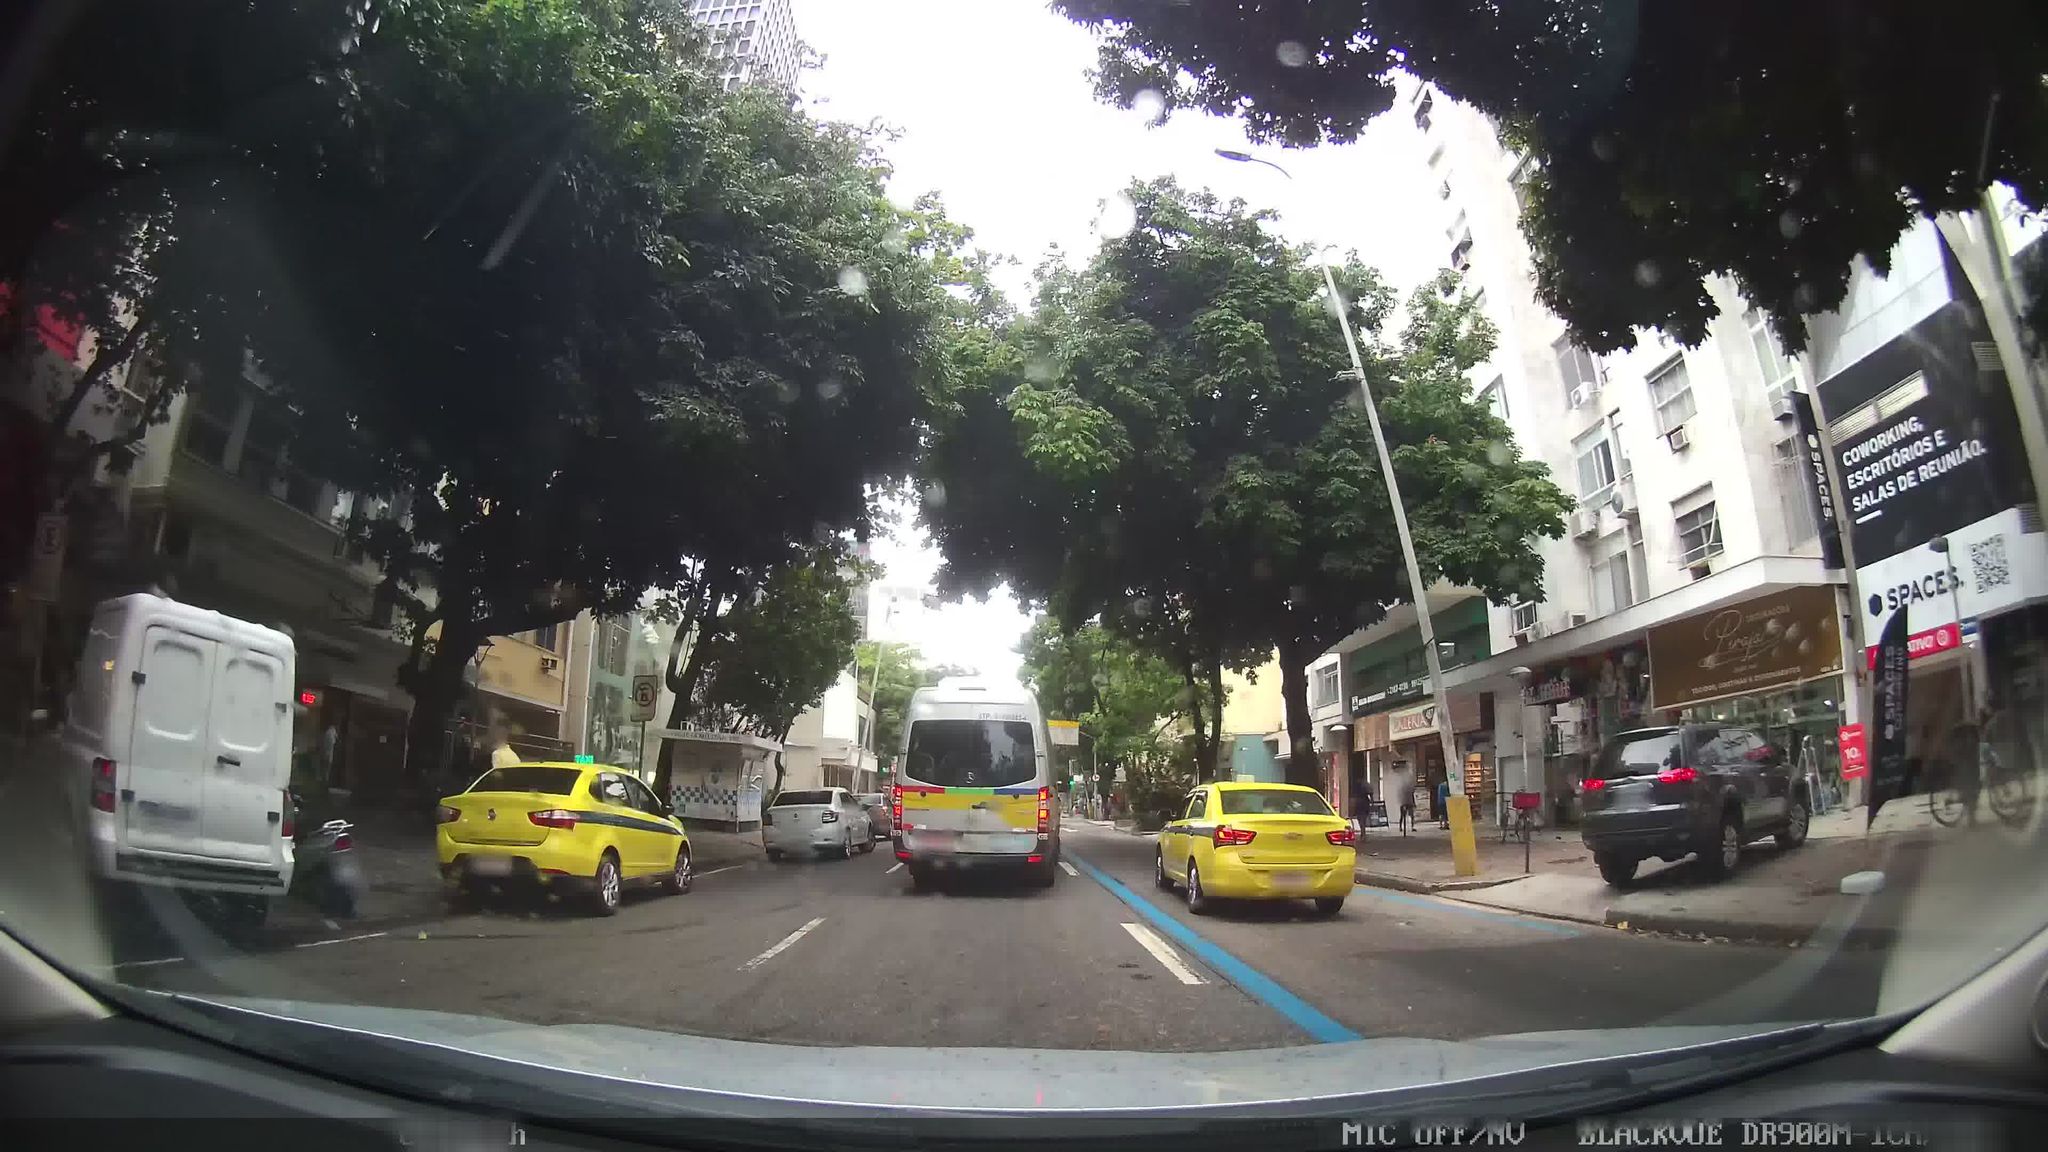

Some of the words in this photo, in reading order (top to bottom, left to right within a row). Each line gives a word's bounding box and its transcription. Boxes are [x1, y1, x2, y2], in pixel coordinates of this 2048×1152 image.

[1842, 416, 1925, 467] COWORKING,
[1846, 436, 1934, 490] ESCRITÓRIOS
[1934, 429, 1948, 447] E
[1852, 480, 1897, 512] SALAS
[1897, 469, 1919, 492] DE
[1918, 439, 1987, 482] REUNIÃO.
[1886, 565, 1965, 612] SPACES.
